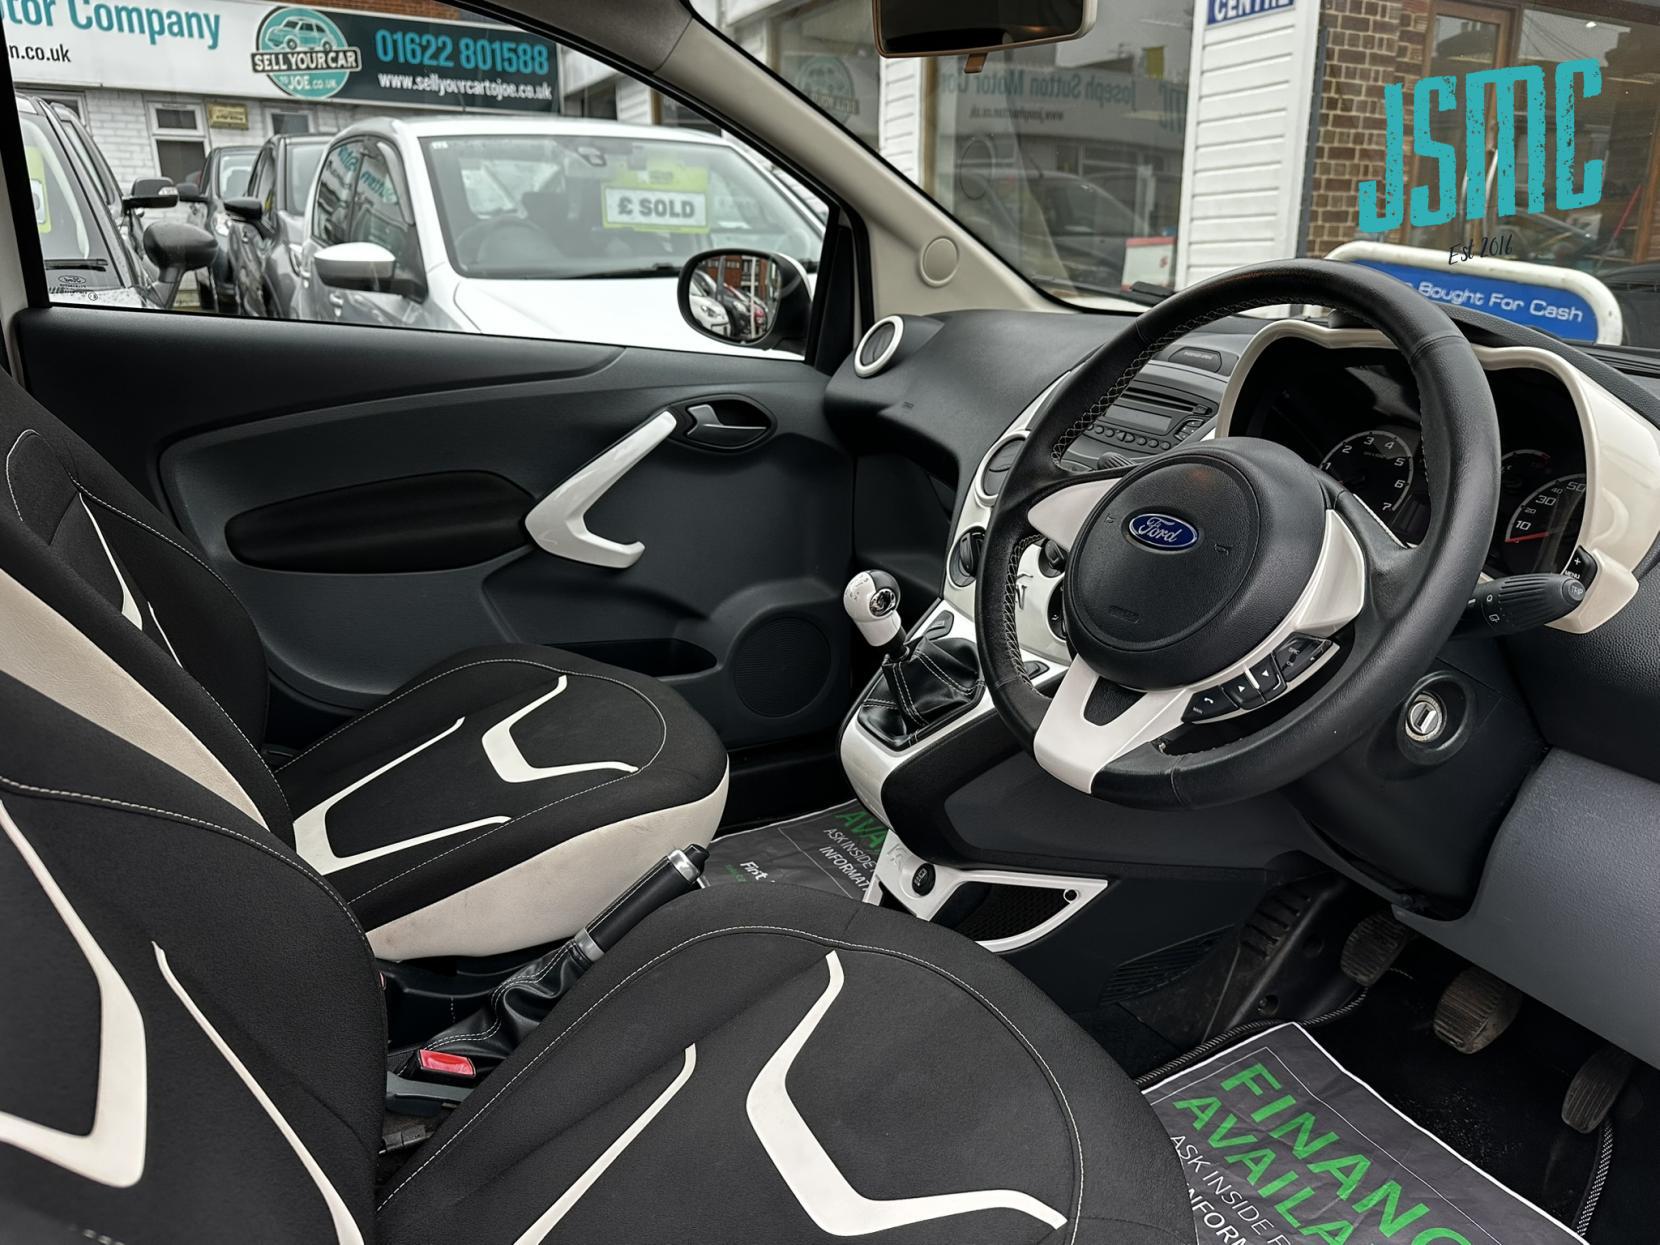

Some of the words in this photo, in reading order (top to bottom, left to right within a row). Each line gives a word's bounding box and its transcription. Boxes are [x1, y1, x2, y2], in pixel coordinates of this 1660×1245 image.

[1213, 0, 1292, 21] CENT
[0, 0, 54, 27] tor
[68, 0, 221, 50] Company
[375, 28, 454, 68] 01622
[458, 36, 549, 76] 801588
[254, 54, 288, 71] SELL
[288, 52, 326, 70] YOUR
[326, 50, 357, 68] CAR
[618, 197, 633, 216] £
[639, 198, 695, 219] SOLD
[1418, 281, 1484, 305] Bought
[1489, 293, 1525, 311] For
[1529, 300, 1583, 323] Cash
[1363, 436, 1375, 446] 3
[1384, 441, 1395, 450] 4
[1341, 445, 1353, 454] 2
[1324, 462, 1332, 471] 1
[1394, 457, 1406, 467] 5
[1394, 479, 1406, 489] 6
[1382, 502, 1392, 511] 7
[1535, 494, 1557, 506] 30
[1138, 516, 1183, 543] Ford
[1515, 520, 1532, 531] 10
[823, 828, 848, 844] ASK
[1170, 1135, 1211, 1173] ASK
[1203, 1170, 1275, 1236] INSIDE
